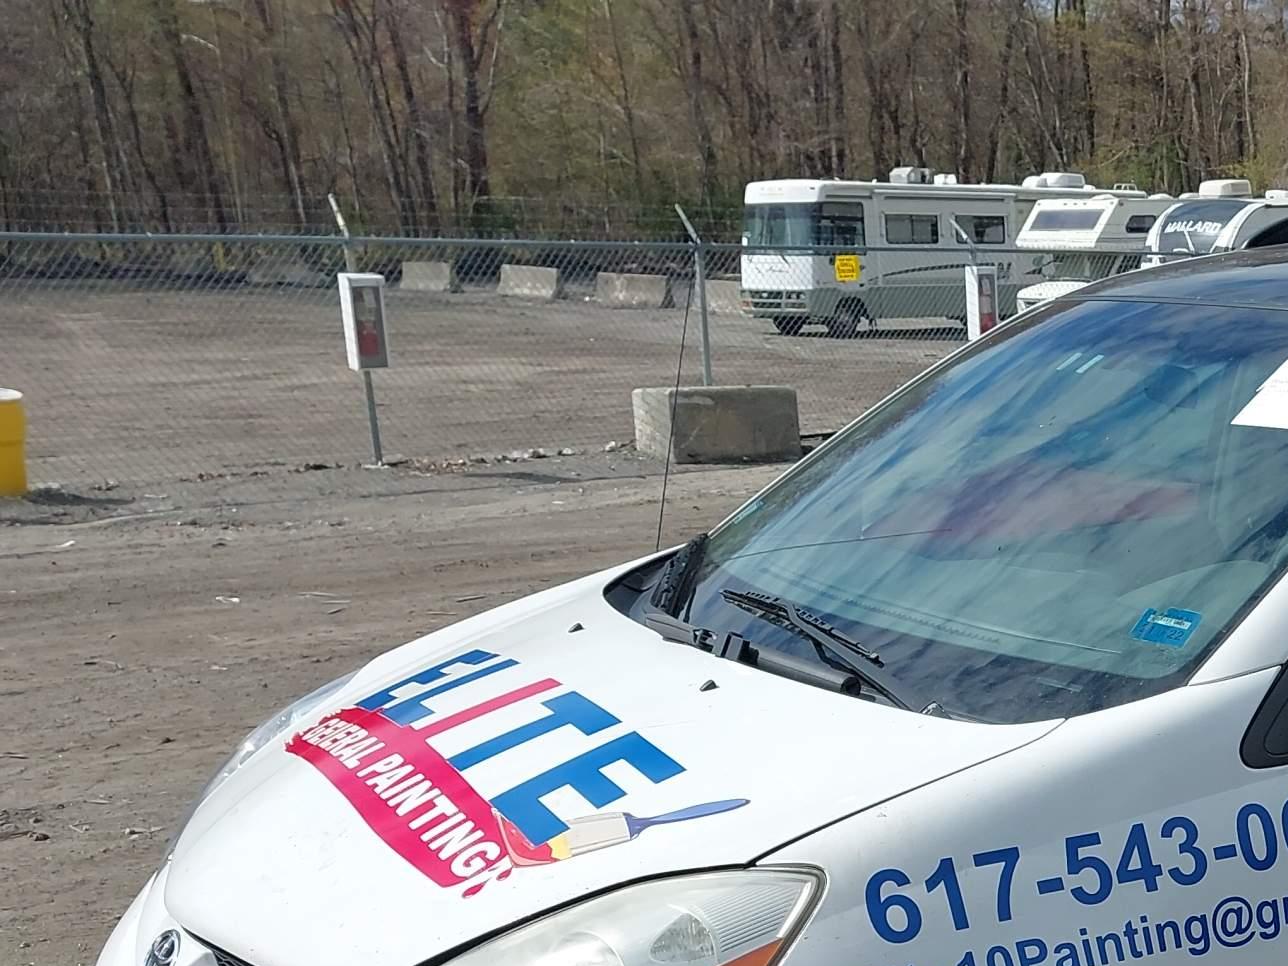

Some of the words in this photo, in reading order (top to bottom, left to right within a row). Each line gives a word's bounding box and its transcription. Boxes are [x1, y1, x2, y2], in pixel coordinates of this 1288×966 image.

[1164, 220, 1222, 234] MALLARD
[355, 649, 687, 846] ELITE
[357, 754, 501, 878] PAINTING
